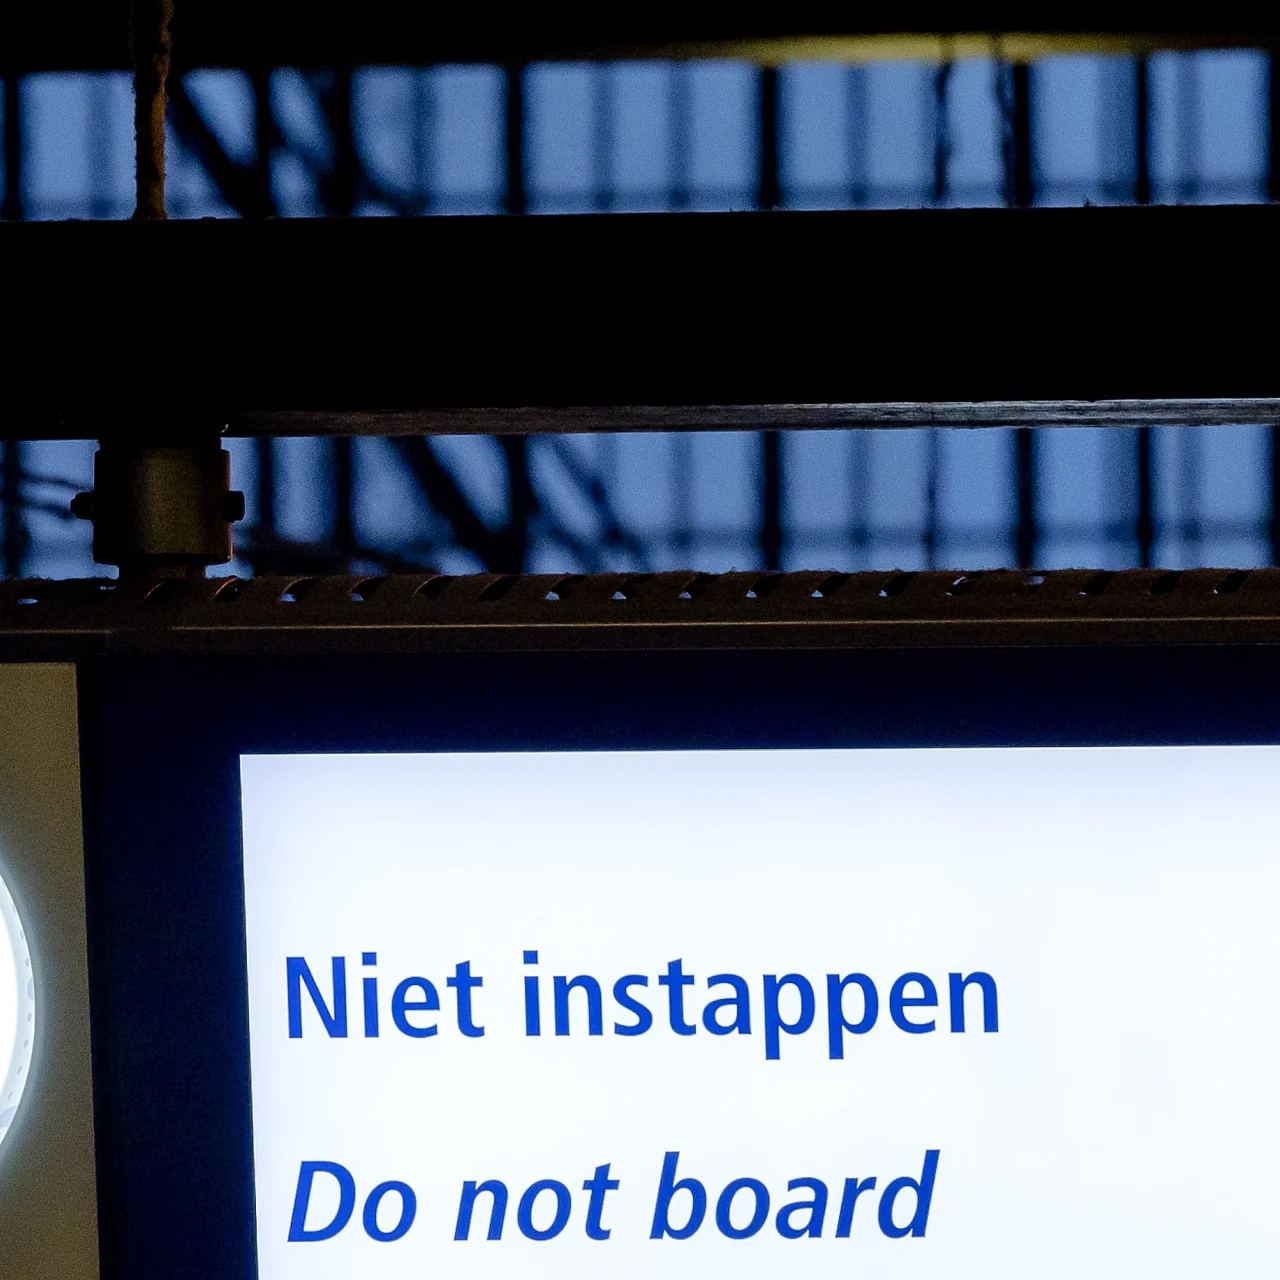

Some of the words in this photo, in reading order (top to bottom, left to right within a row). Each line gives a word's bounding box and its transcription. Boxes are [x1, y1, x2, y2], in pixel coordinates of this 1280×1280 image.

[285, 951, 485, 1039] Niet
[522, 949, 1000, 1061] instappen
[287, 1160, 417, 1243] Do
[453, 1163, 620, 1242] not
[649, 1149, 941, 1241] board
